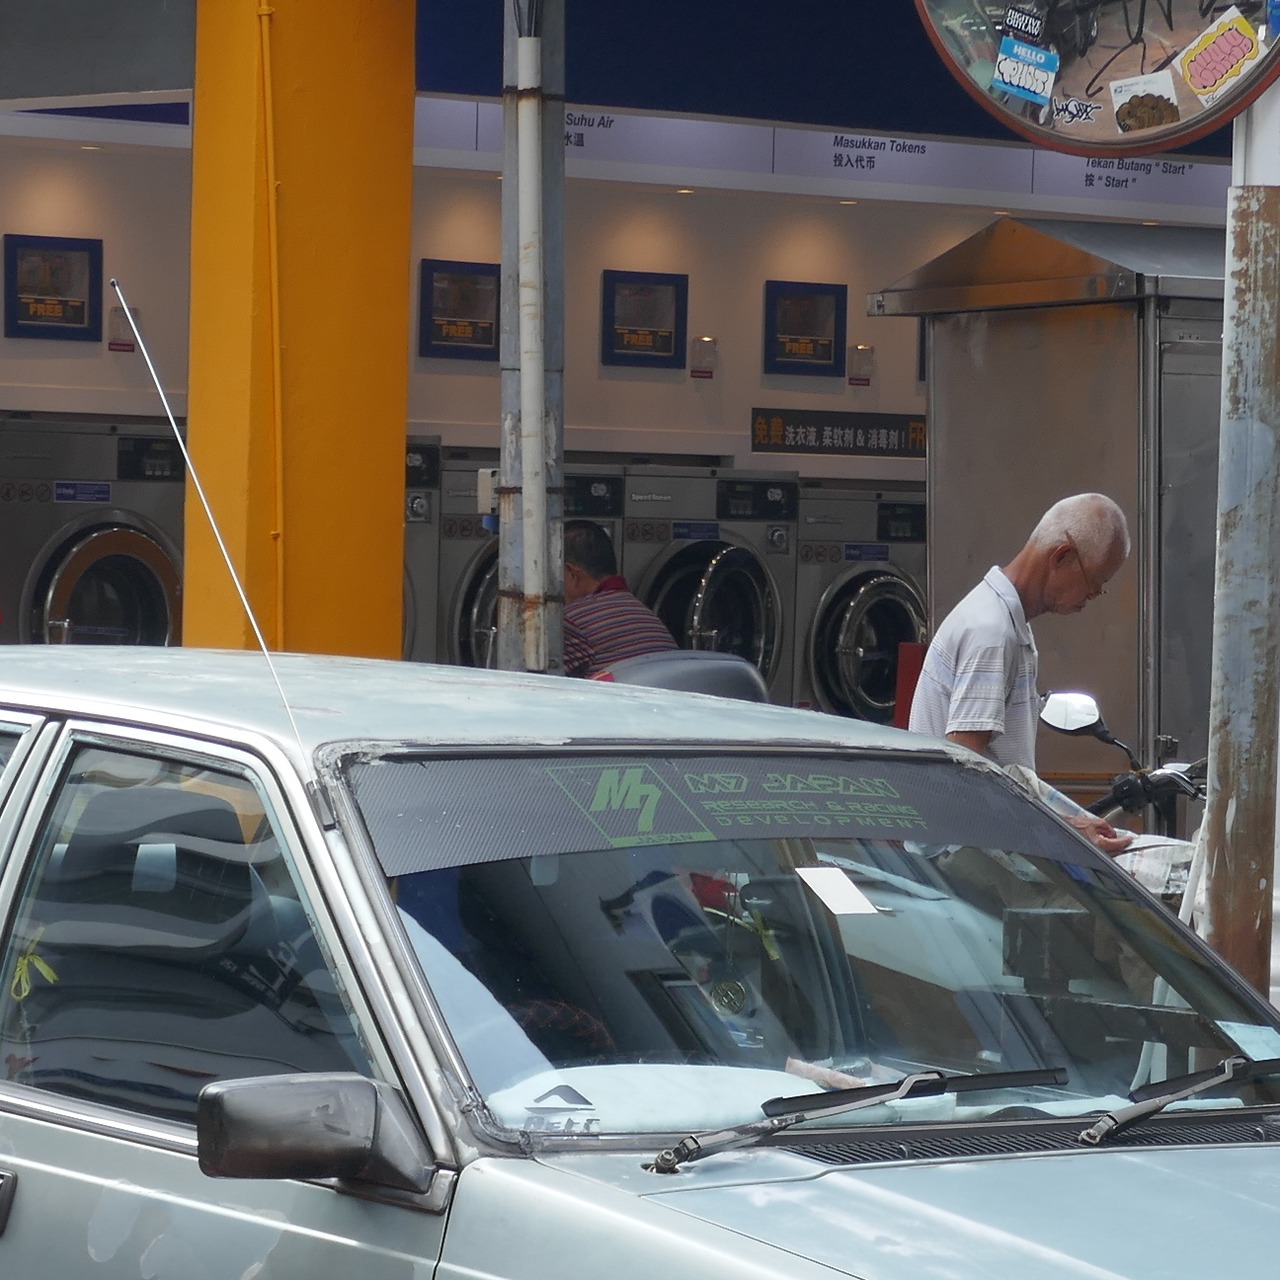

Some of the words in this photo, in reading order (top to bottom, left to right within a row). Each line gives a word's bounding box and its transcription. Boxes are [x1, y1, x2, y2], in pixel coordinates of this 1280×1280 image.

[1013, 44, 1046, 64] HELLO
[565, 113, 595, 128] Suhu
[597, 116, 615, 129] Air
[833, 135, 886, 152] Masukkan
[889, 139, 927, 155] Tokens
[833, 153, 876, 169] 投入代币
[1086, 158, 1115, 170] Tekan
[1117, 159, 1152, 174] Butang
[29, 303, 64, 317] FREE
[442, 324, 473, 338] FREE
[624, 334, 653, 347] FREE
[786, 342, 814, 355] FREE
[908, 422, 926, 449] FR
[761, 772, 901, 798] JAPAN
[589, 768, 663, 833] M7
